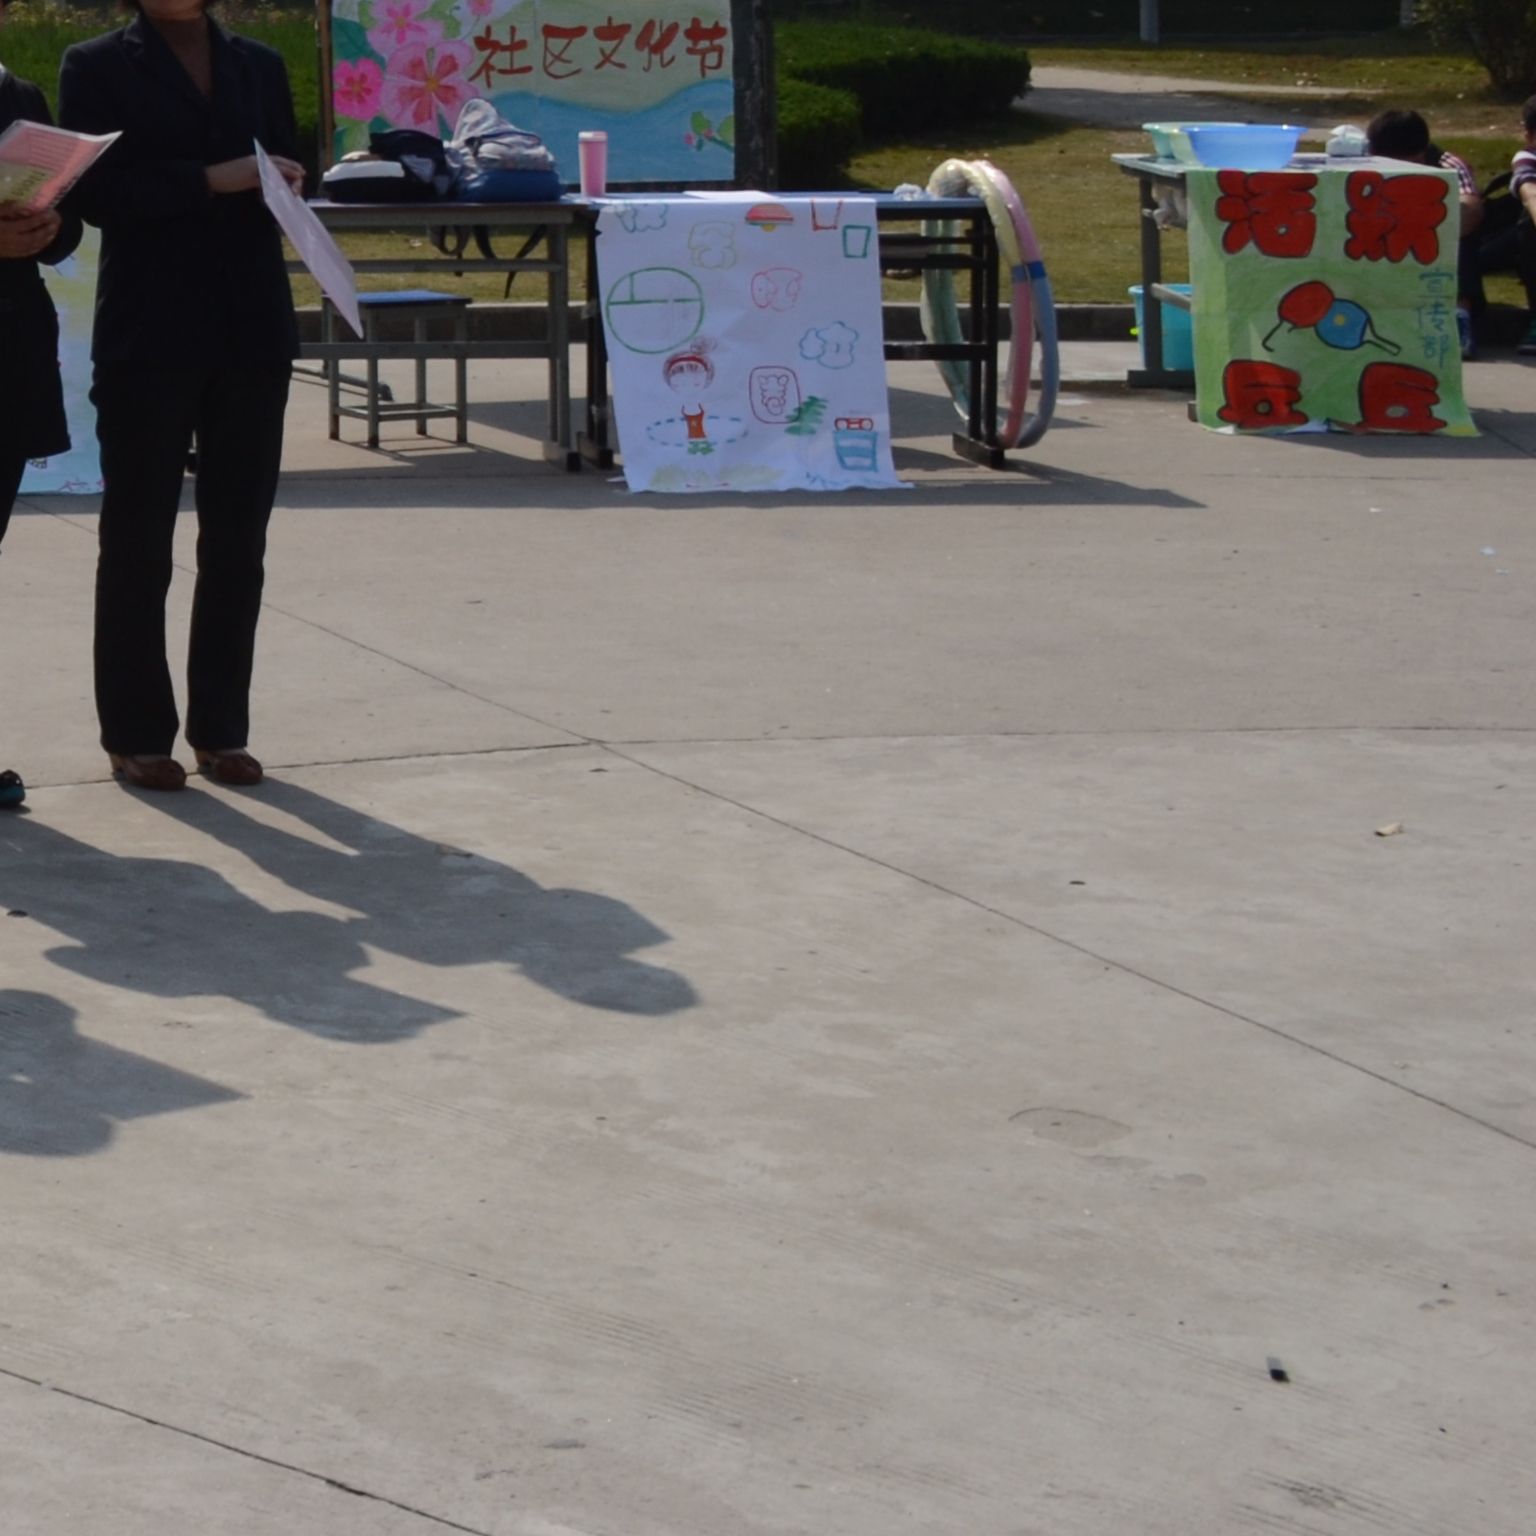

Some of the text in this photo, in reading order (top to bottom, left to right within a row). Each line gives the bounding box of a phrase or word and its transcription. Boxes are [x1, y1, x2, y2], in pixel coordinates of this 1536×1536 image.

[468, 16, 729, 89] 社区文化节
